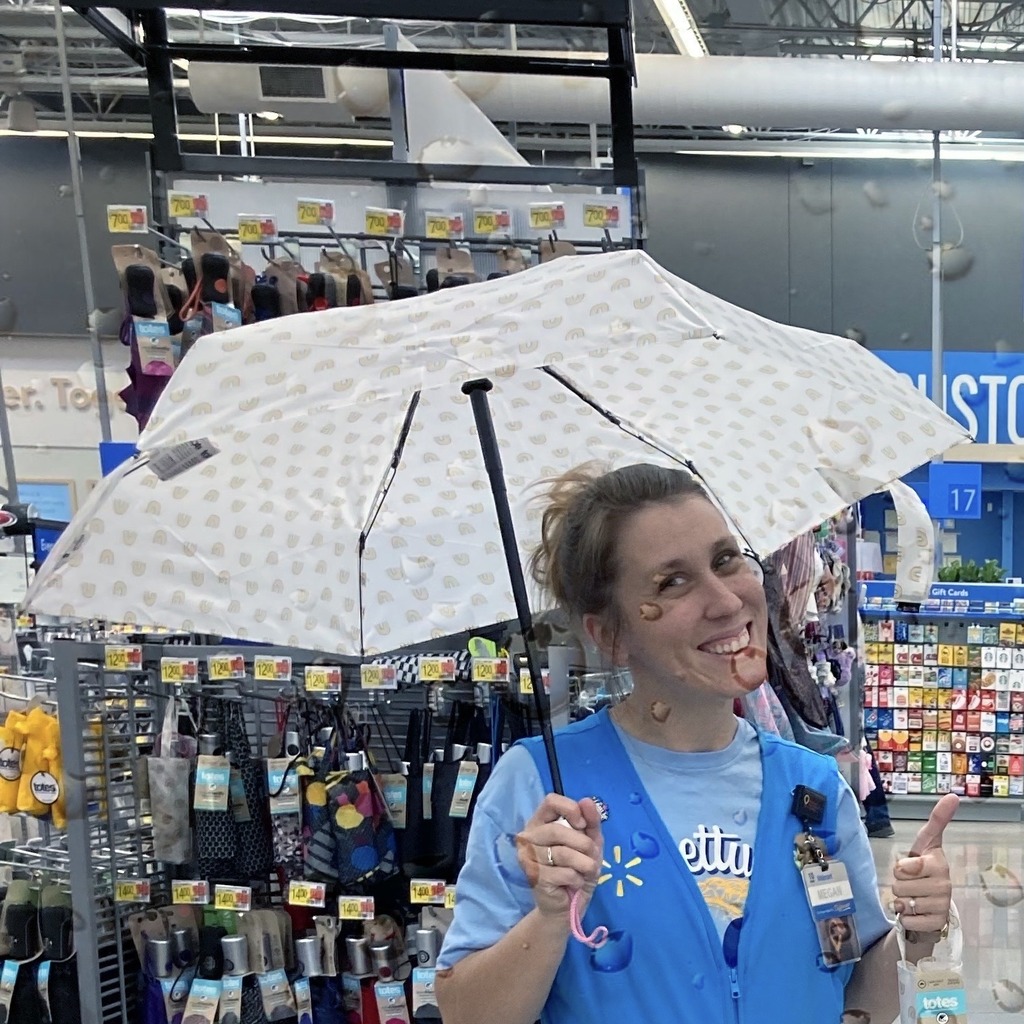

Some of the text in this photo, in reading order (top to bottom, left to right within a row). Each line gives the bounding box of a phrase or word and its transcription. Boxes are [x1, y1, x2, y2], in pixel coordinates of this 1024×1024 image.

[950, 488, 977, 513] 17
[932, 588, 969, 597] Gift Cards
[33, 782, 56, 792] totes
[817, 885, 843, 900] MEGAN
[416, 969, 436, 980] tote
[379, 985, 402, 996] totes
[923, 995, 959, 1011] totes
